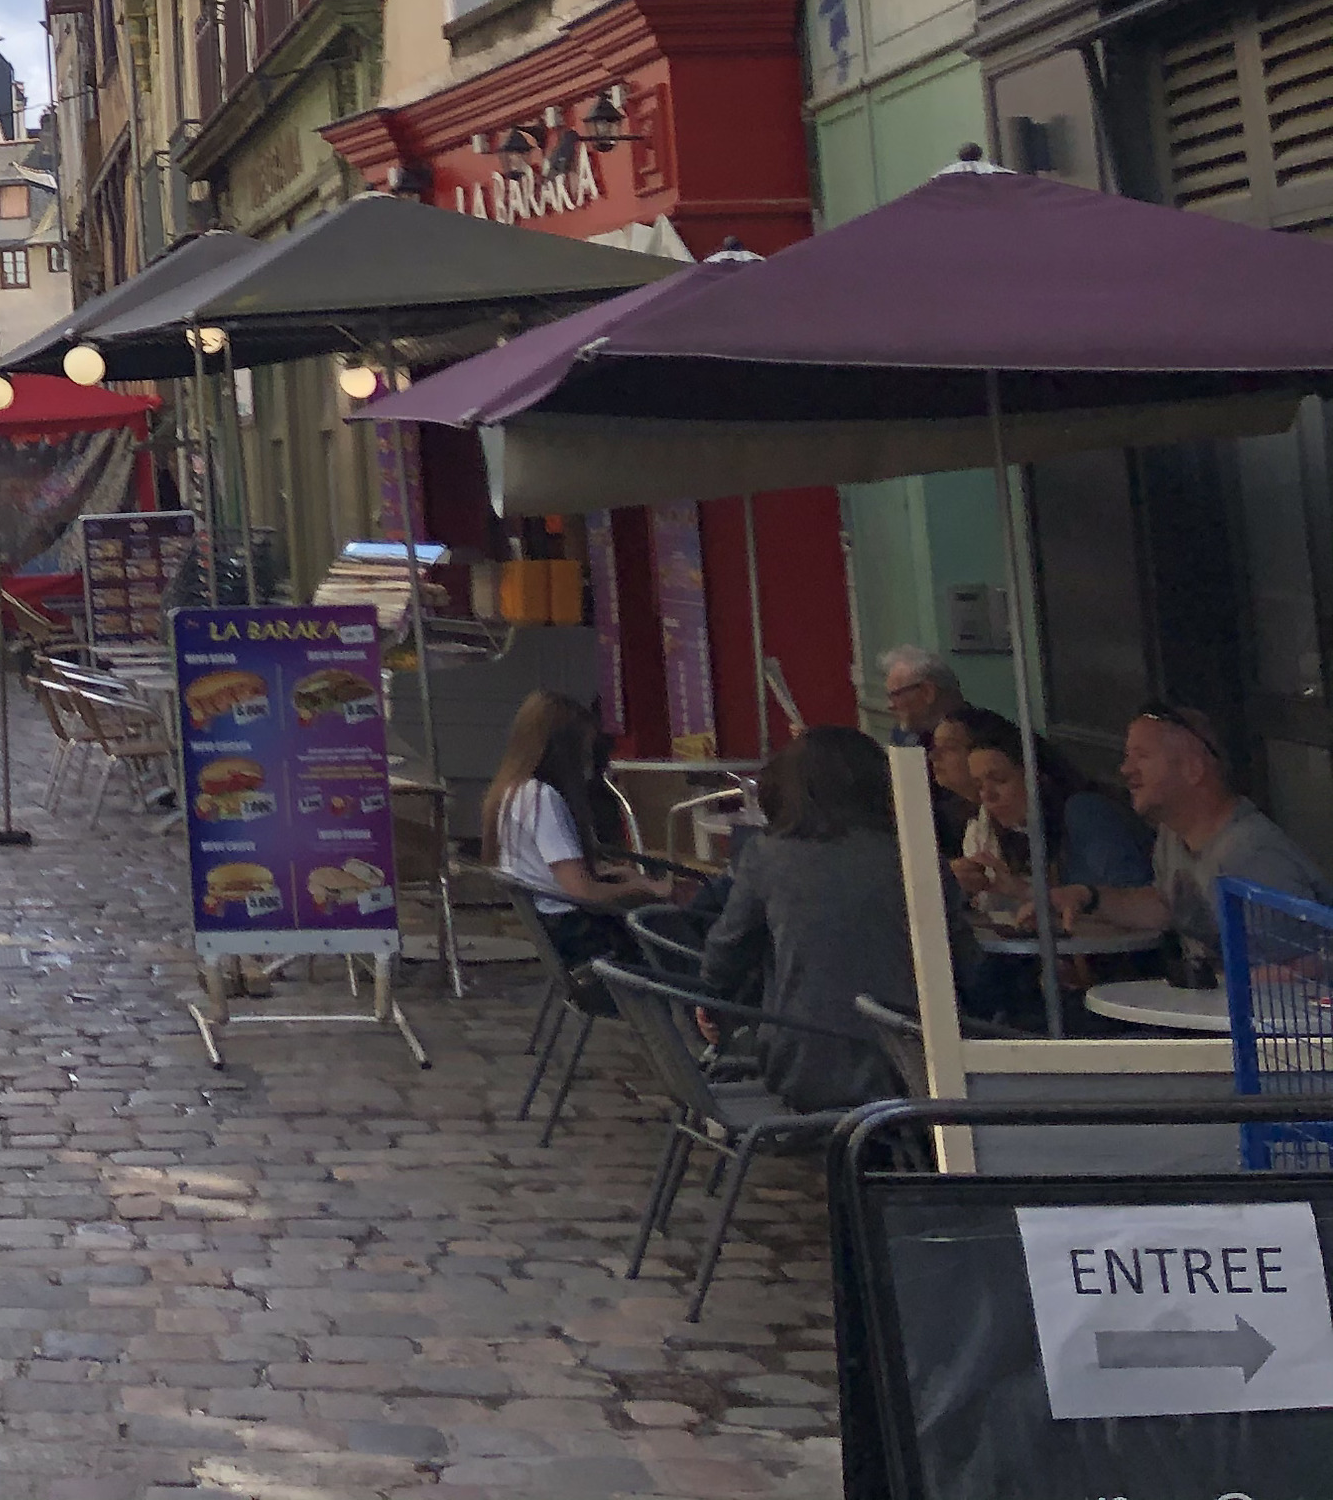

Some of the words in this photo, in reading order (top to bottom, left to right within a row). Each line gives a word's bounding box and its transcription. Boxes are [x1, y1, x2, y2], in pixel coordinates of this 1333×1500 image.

[491, 141, 599, 226] BARAKA
[208, 620, 242, 642] LA
[246, 619, 342, 642] BARAKA
[1069, 1247, 1288, 1295] ENTREE
